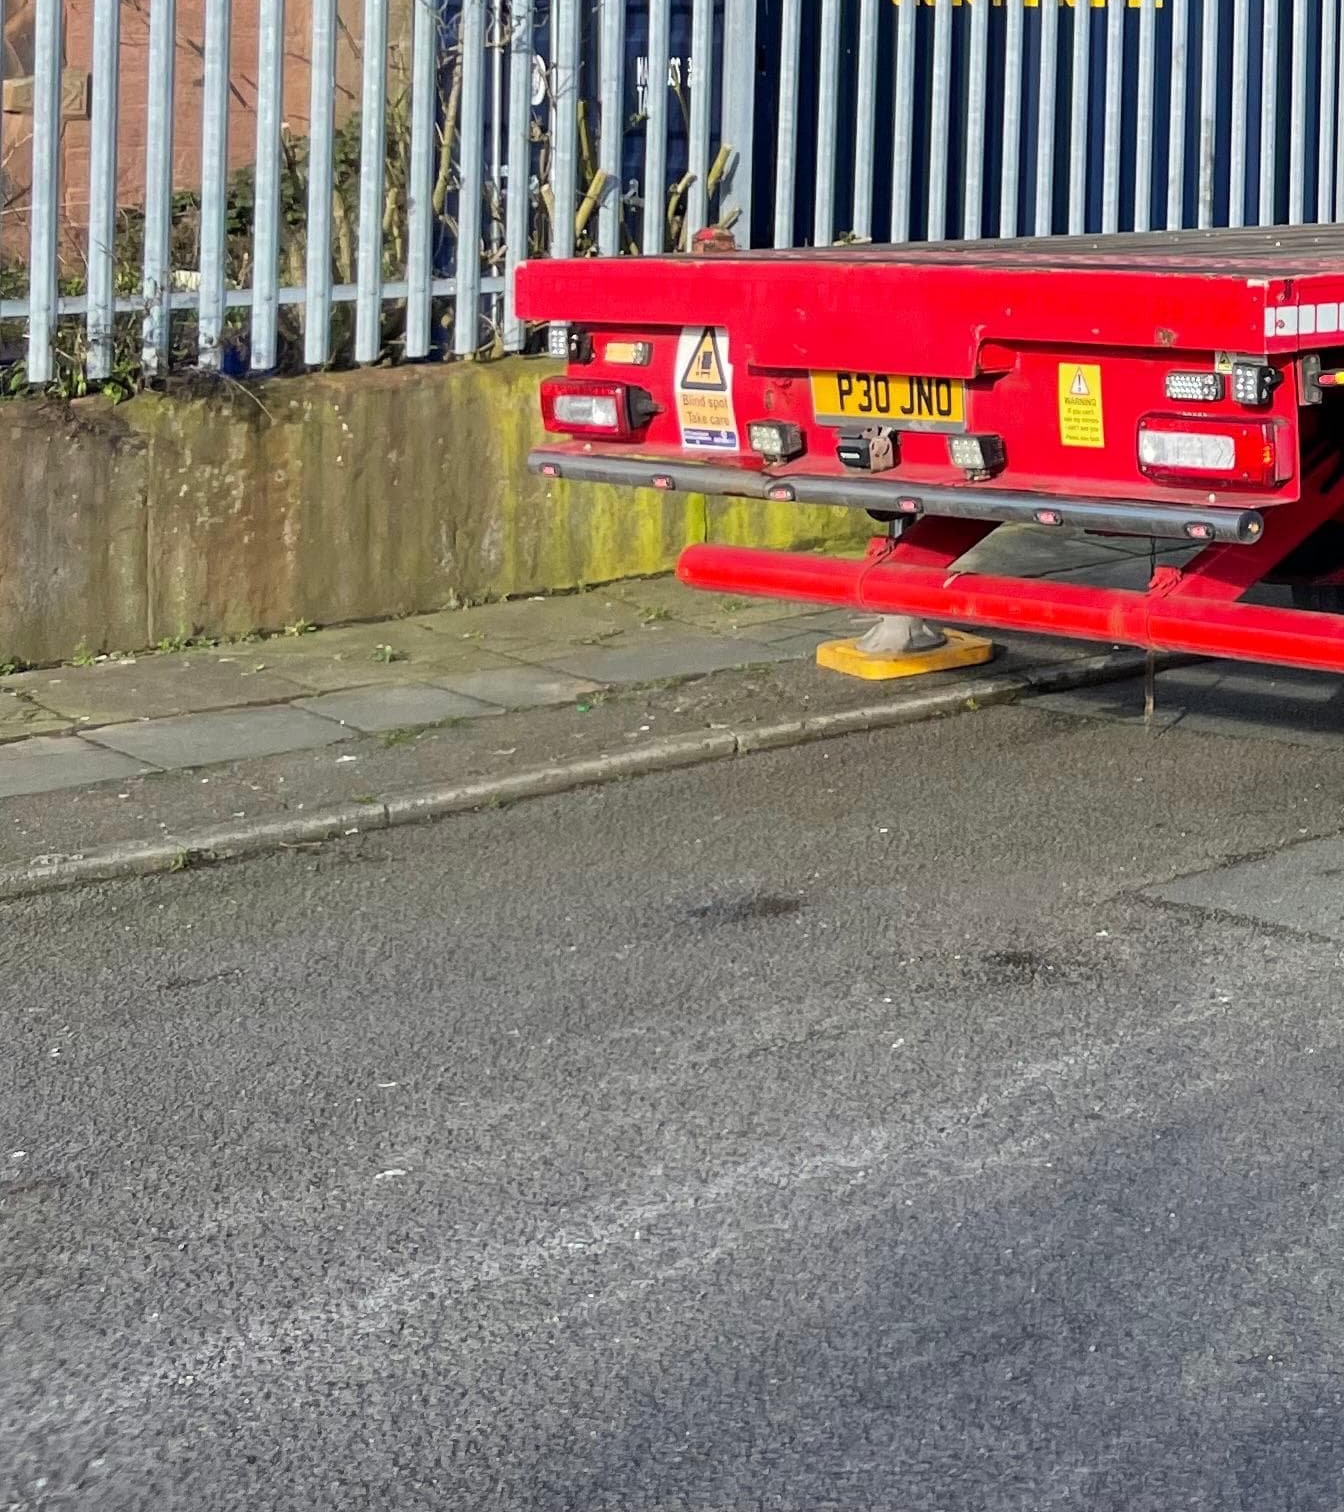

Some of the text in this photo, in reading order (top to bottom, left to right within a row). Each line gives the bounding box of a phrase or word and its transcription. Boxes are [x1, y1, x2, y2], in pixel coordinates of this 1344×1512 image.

[683, 394, 729, 410] Blind spot
[837, 372, 952, 416] P30 JNO
[687, 411, 730, 426] Take care
